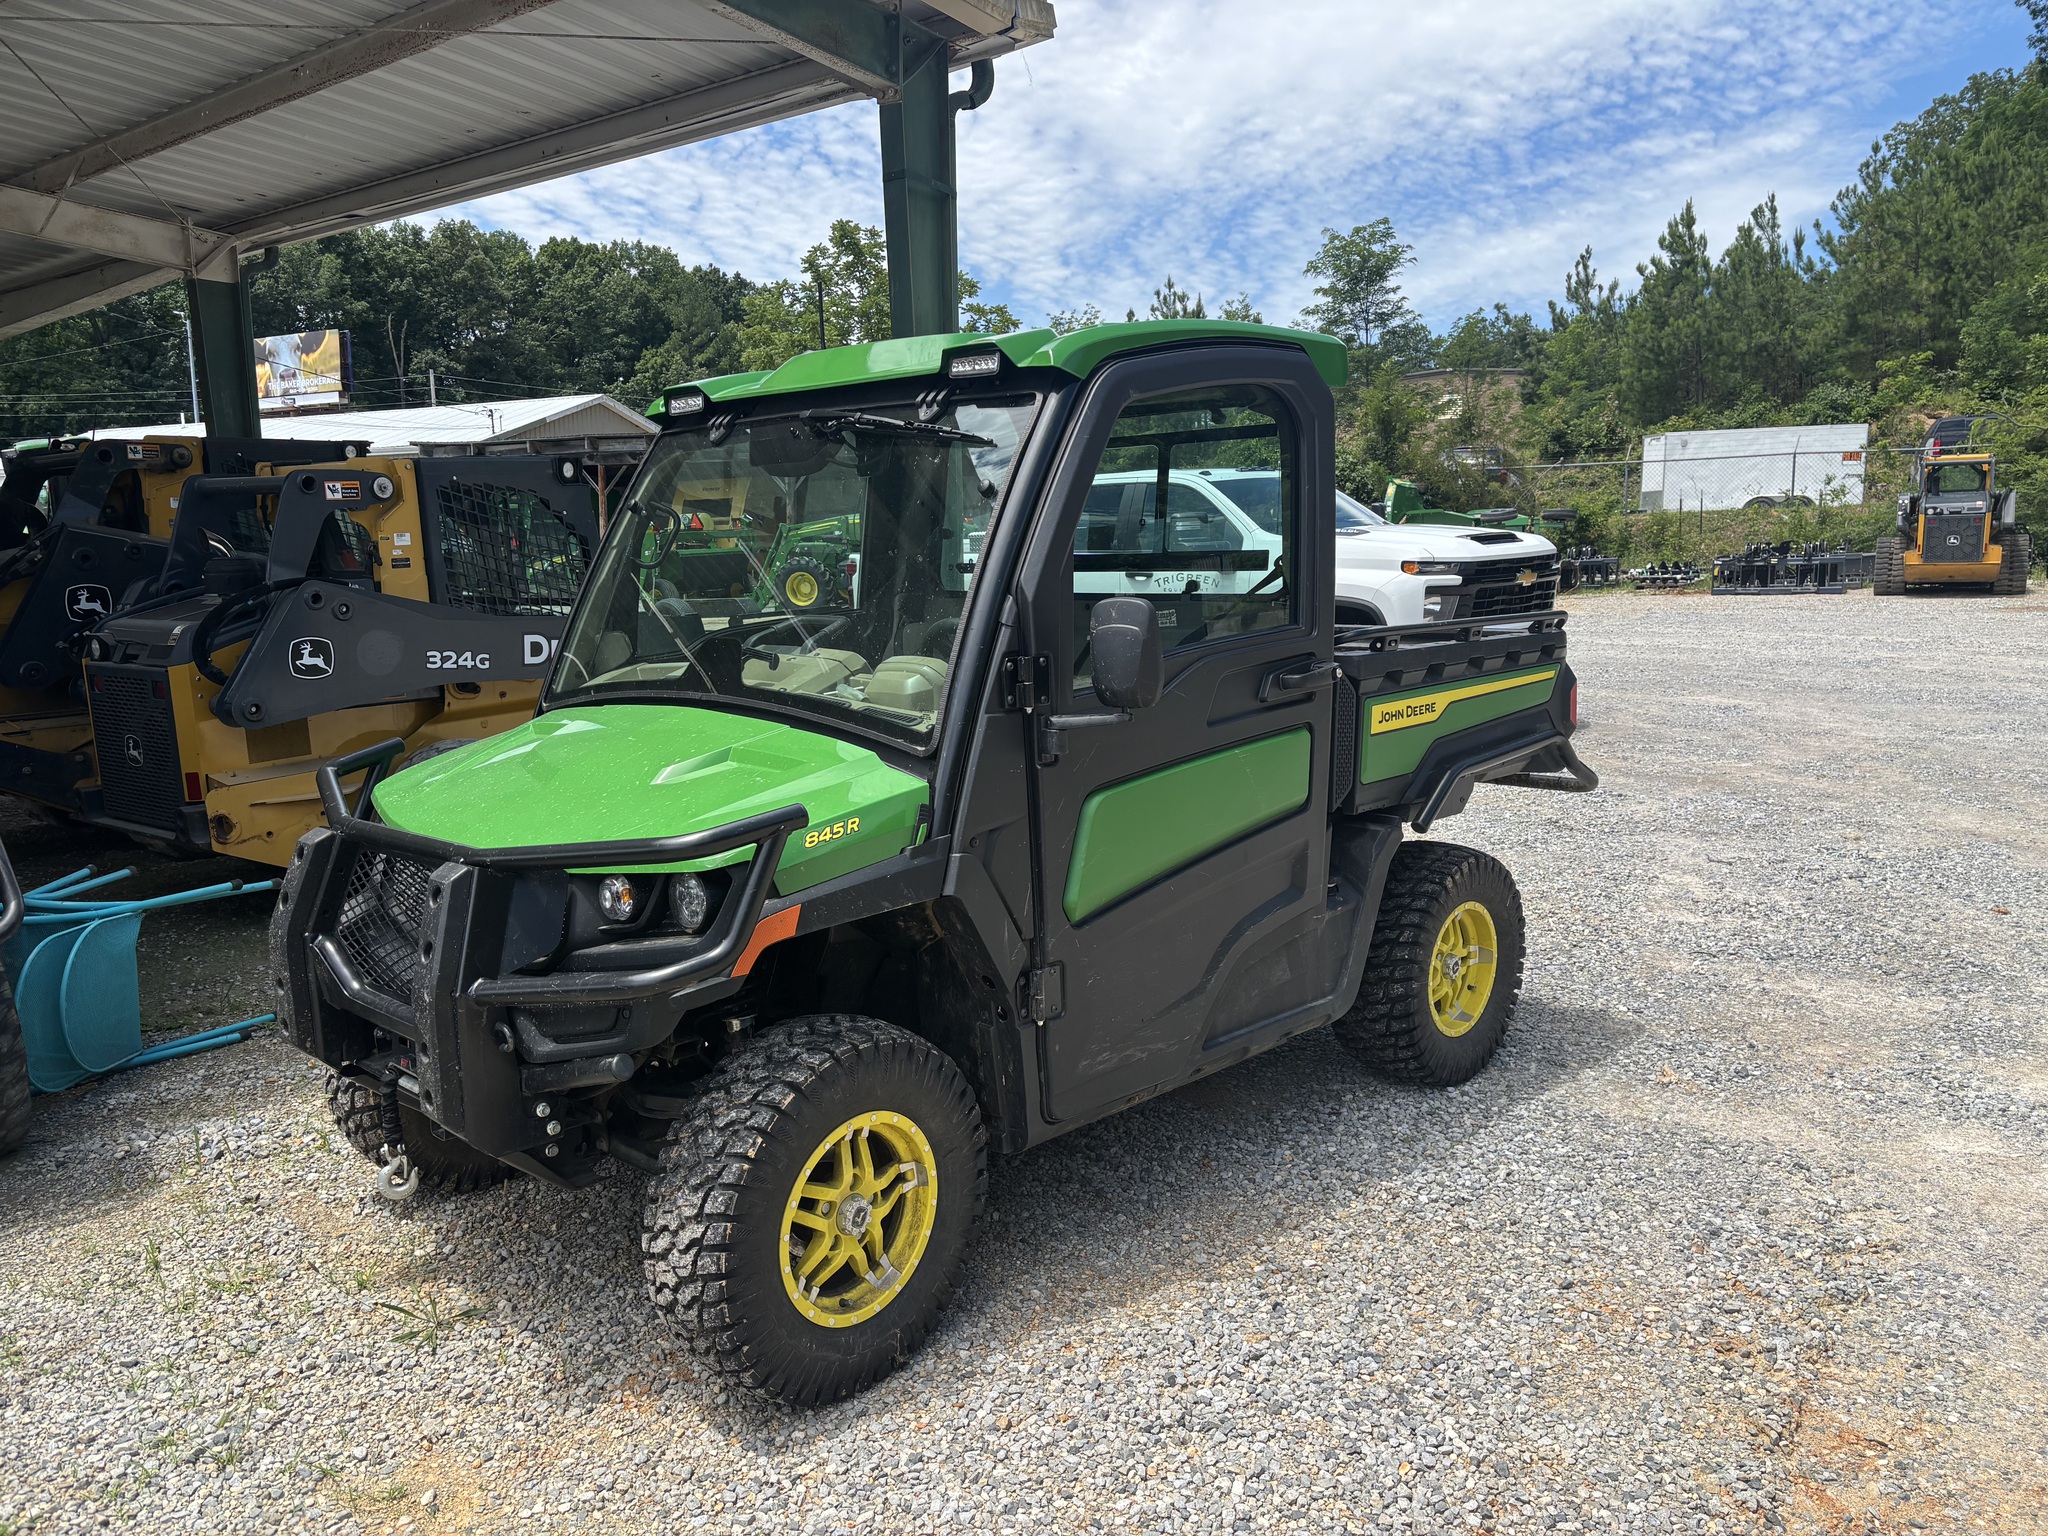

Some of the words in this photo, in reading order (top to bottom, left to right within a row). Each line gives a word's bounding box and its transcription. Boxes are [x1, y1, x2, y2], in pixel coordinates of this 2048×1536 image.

[267, 382, 280, 391] THE
[281, 380, 300, 389] BAKER
[302, 375, 339, 387] BROKERAGE
[1154, 572, 1220, 589] TRIGREEN
[426, 651, 490, 669] 324G
[1378, 709, 1404, 724] JOHN
[1406, 702, 1437, 718] DEERE
